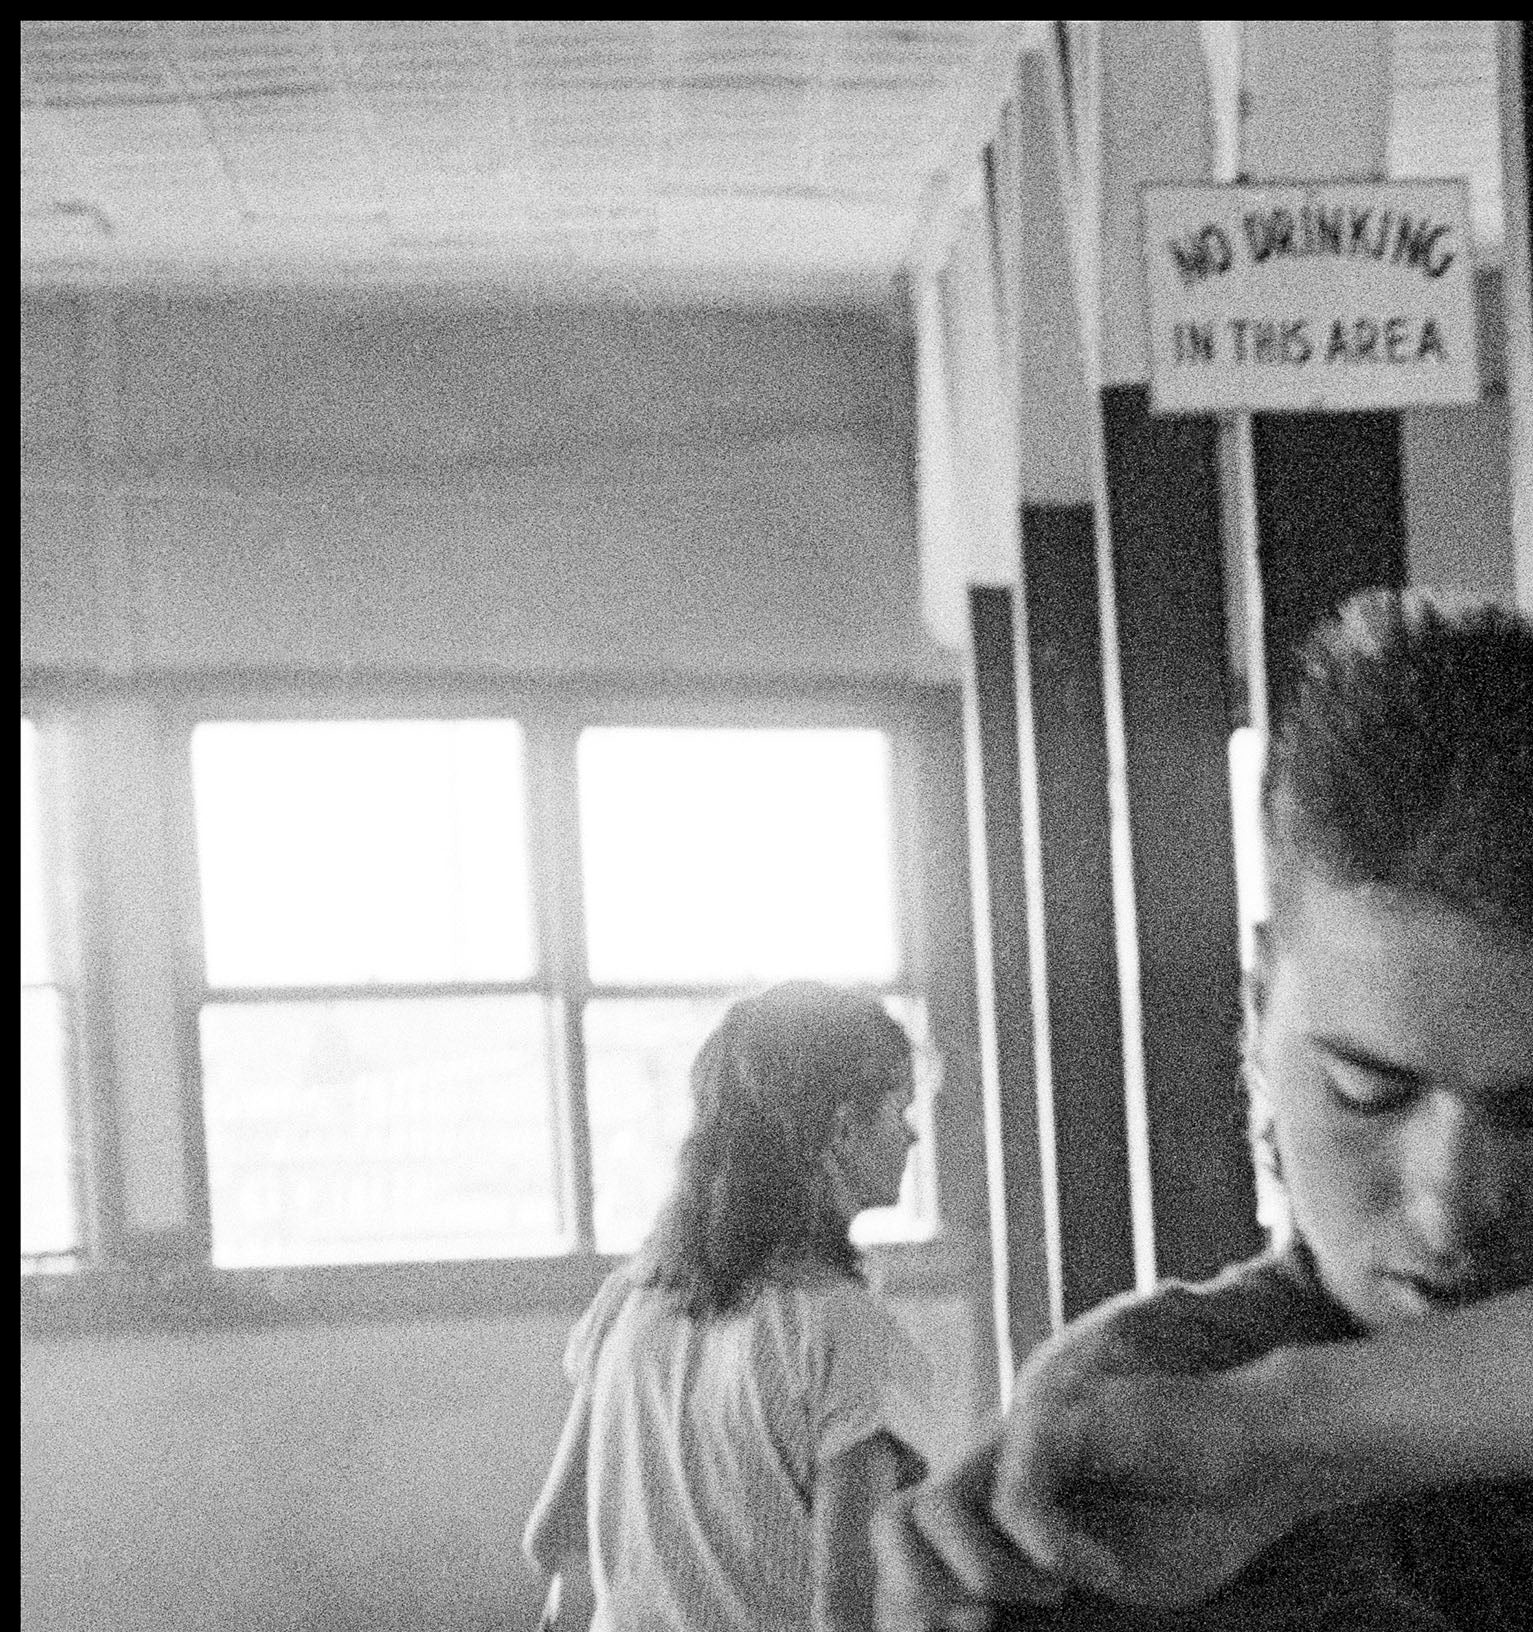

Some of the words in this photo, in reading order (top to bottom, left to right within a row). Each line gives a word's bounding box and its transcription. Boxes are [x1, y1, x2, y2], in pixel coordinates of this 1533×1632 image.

[1169, 222, 1233, 284] NO
[1241, 204, 1455, 280] DRINKING
[1173, 321, 1215, 366] IN
[1229, 319, 1313, 367] THIS
[1325, 318, 1447, 366] AREA
